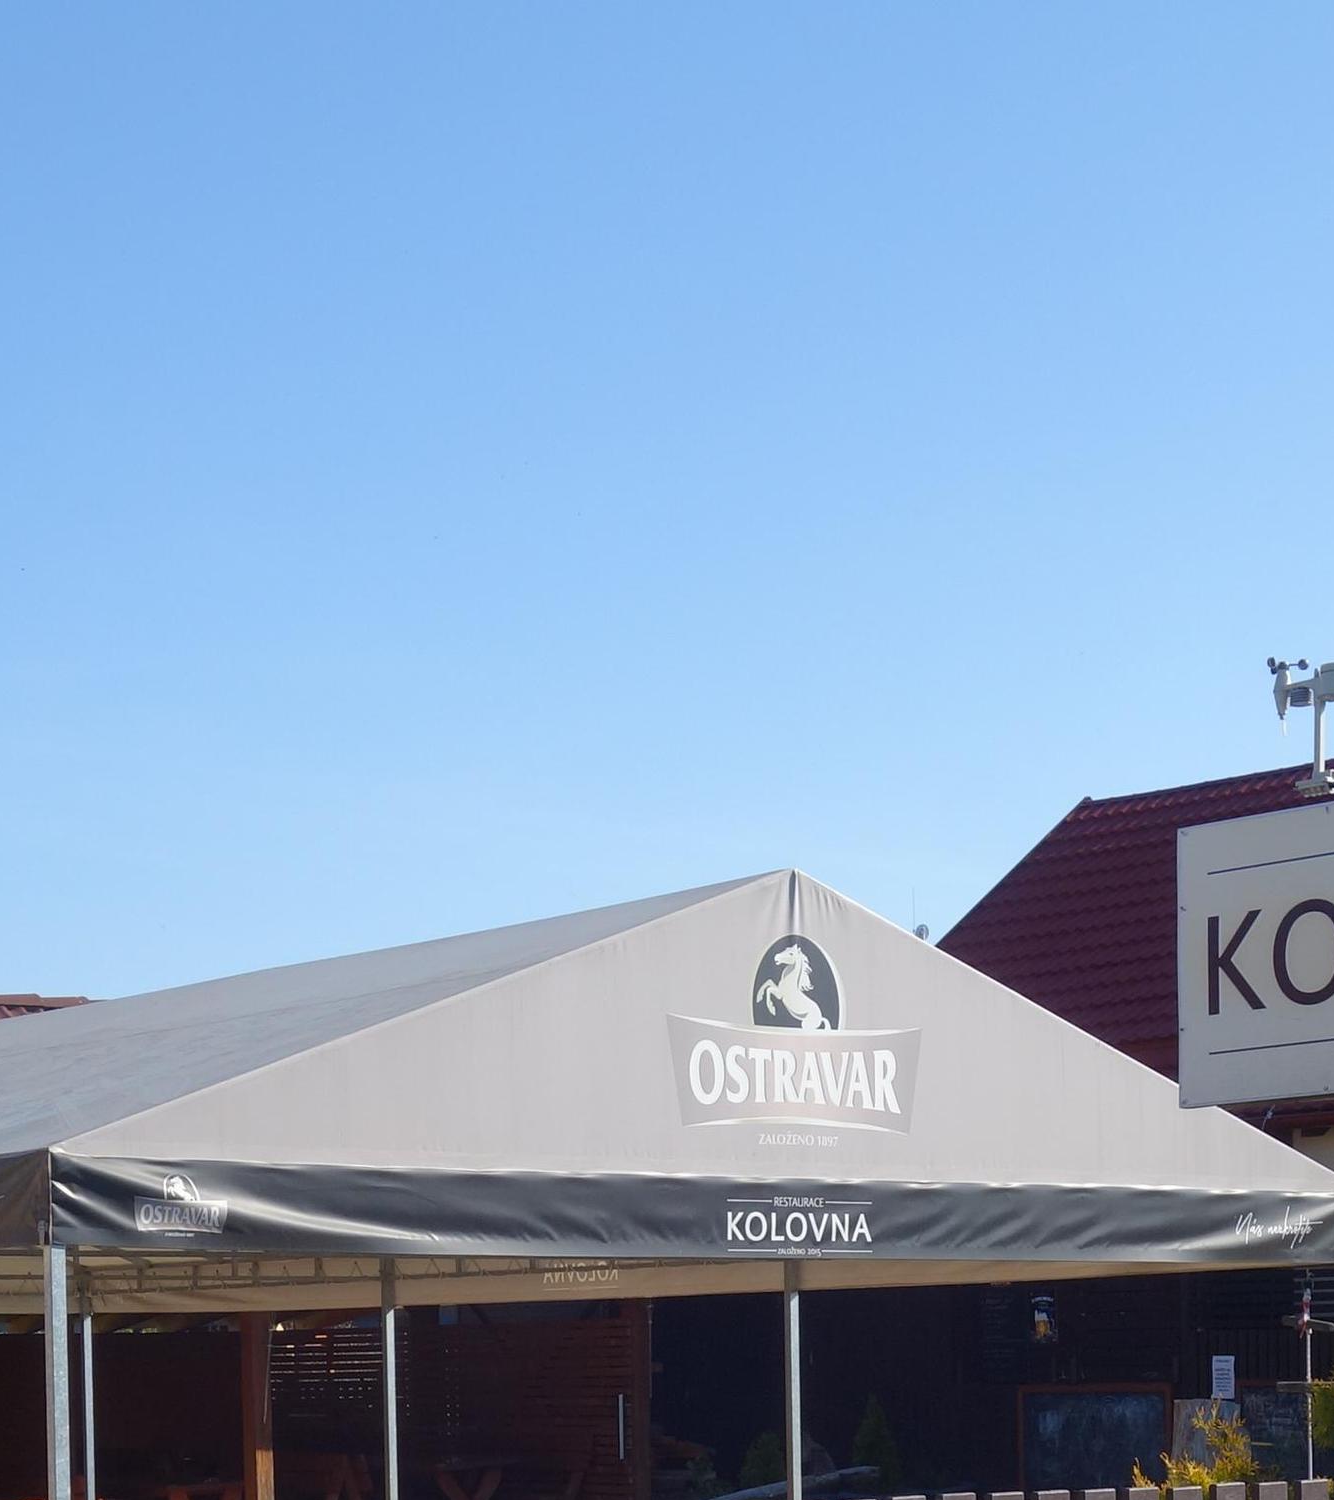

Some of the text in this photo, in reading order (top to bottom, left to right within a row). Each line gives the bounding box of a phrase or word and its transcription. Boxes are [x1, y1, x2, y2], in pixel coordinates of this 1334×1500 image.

[689, 1039, 901, 1115] OSTRAVAR
[140, 1203, 220, 1227] OSTRAVAR
[773, 1196, 825, 1208] RESTAURACE
[726, 1211, 873, 1242] KOLOVNA
